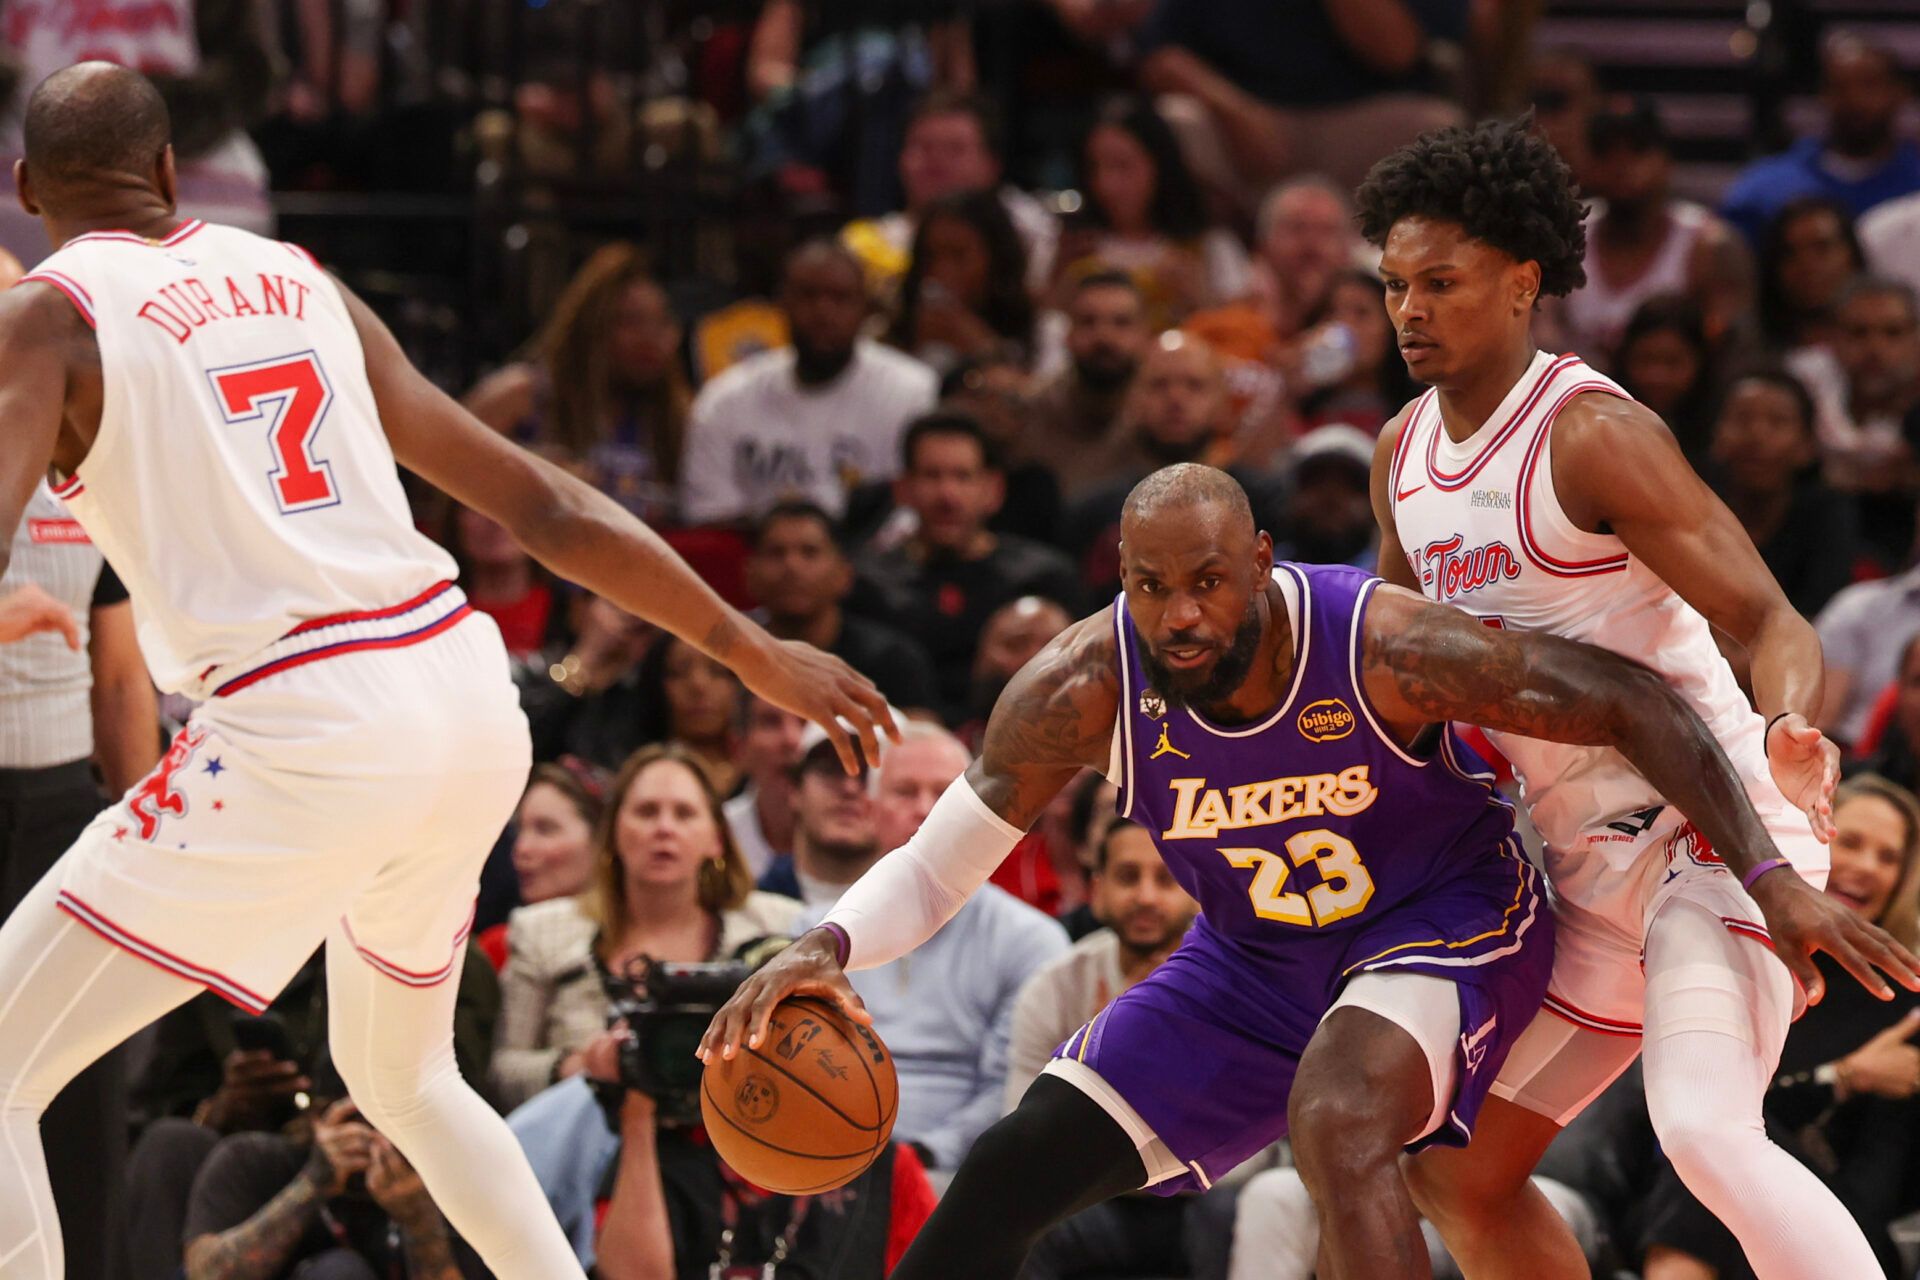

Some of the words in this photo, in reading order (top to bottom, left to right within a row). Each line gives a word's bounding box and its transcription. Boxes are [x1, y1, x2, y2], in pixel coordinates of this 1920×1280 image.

[137, 273, 311, 344] DURANT
[205, 348, 341, 515] 7
[1470, 498, 1511, 509] HERMANN
[1471, 489, 1511, 501] MEMORIAL
[1302, 709, 1352, 729] bibigo
[1161, 765, 1379, 841] LAKERS
[1215, 828, 1376, 928] 23
